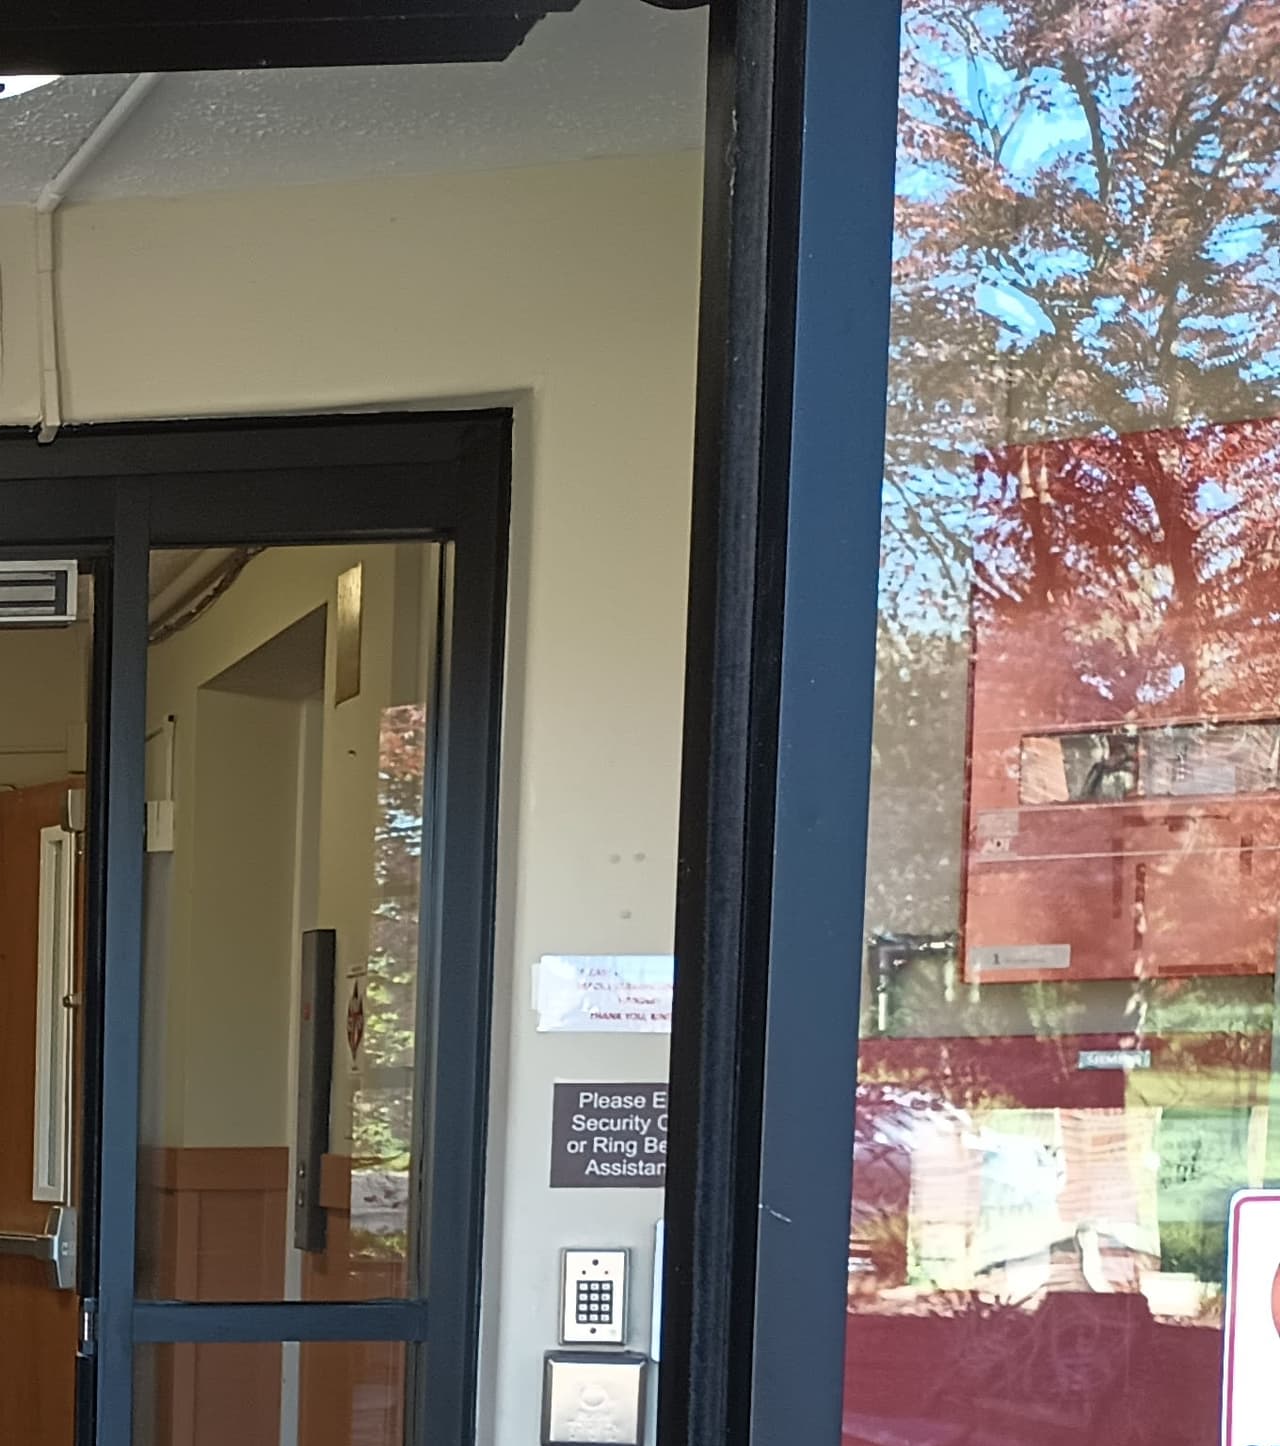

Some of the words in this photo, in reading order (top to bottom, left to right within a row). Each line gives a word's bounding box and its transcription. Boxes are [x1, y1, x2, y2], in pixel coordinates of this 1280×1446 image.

[579, 1091, 646, 1109] Please
[571, 1114, 652, 1135] Security
[566, 1140, 588, 1153] or
[593, 1136, 638, 1158] Ring
[644, 1136, 668, 1154] Be
[584, 1159, 667, 1177] Assistan
